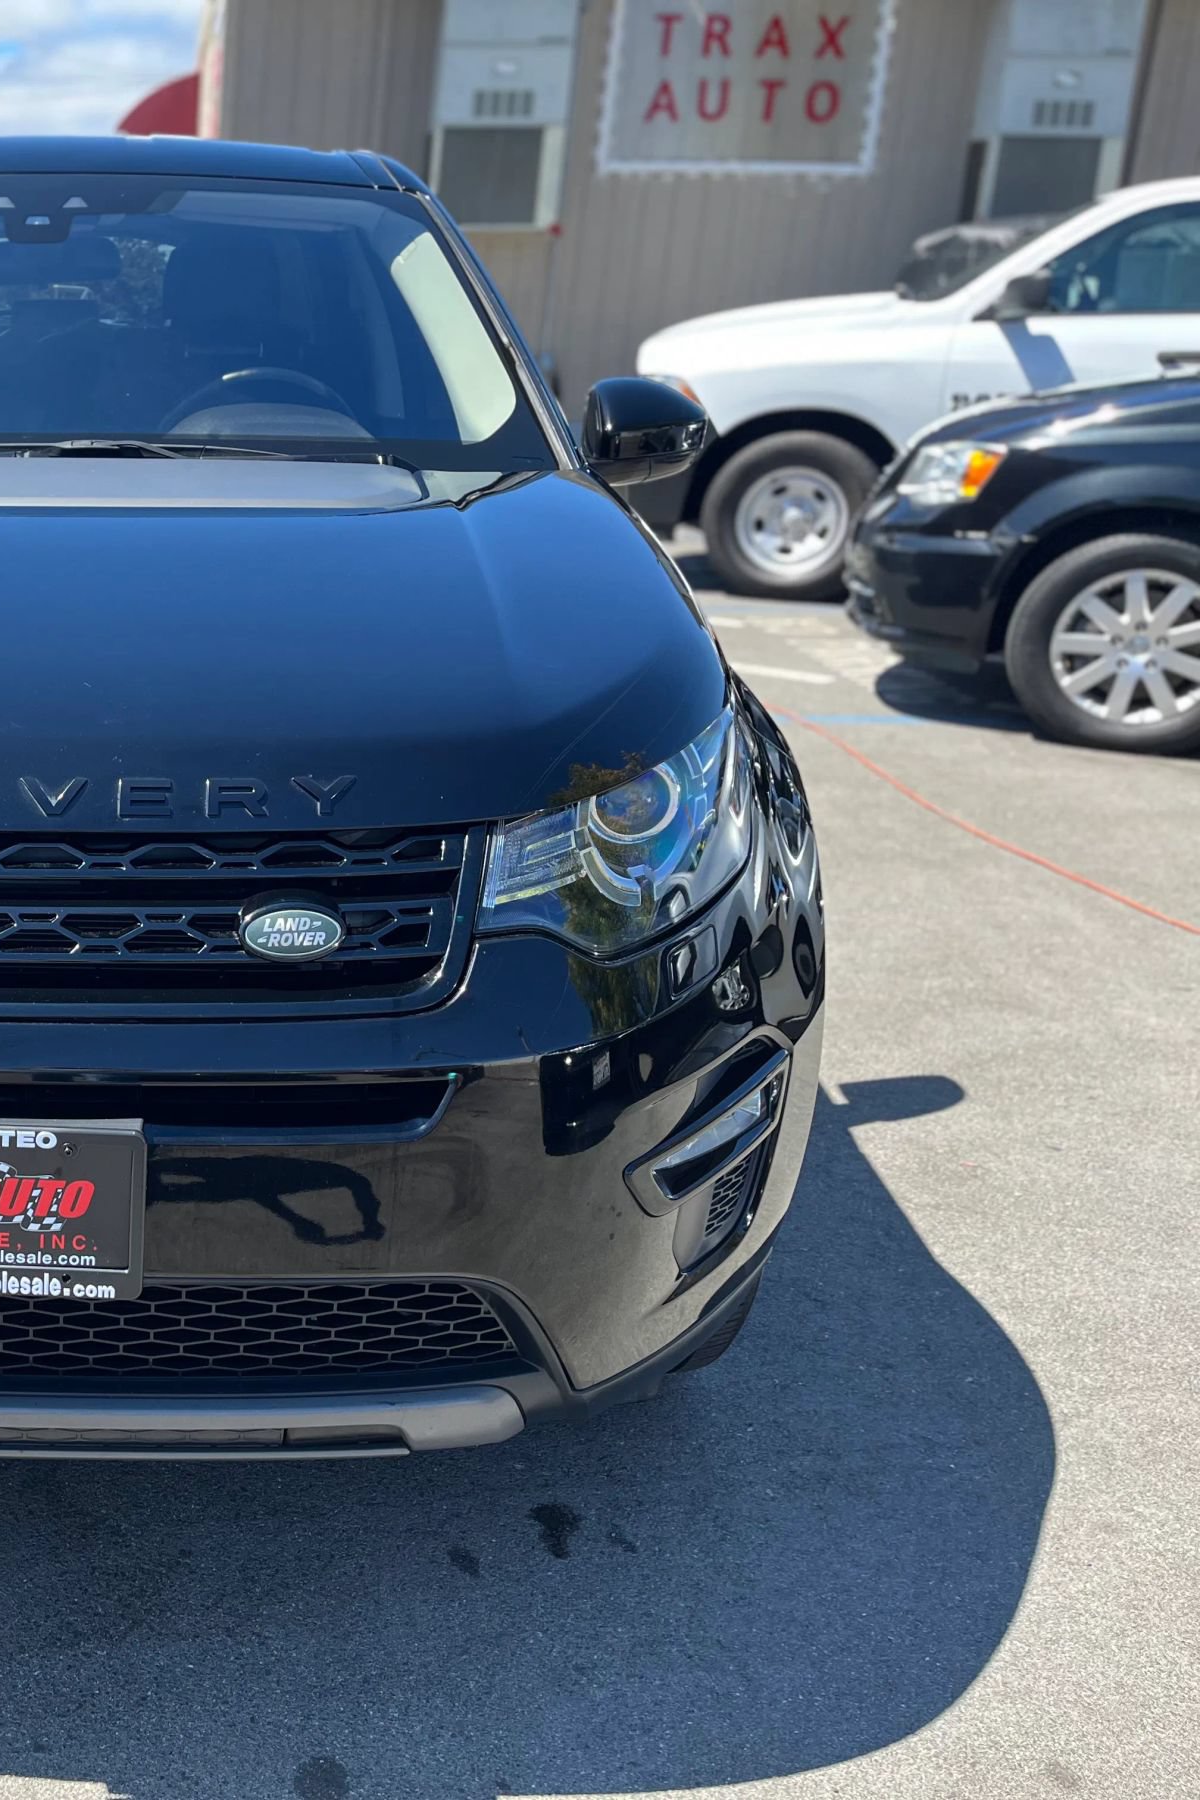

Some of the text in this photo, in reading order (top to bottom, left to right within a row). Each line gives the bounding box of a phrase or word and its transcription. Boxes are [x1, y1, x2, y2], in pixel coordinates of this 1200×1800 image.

[655, 12, 851, 60] TRAX
[643, 76, 841, 125] AUTO
[263, 917, 311, 932] LAND
[267, 932, 326, 947] ROVER
[39, 1234, 98, 1251] INC.
